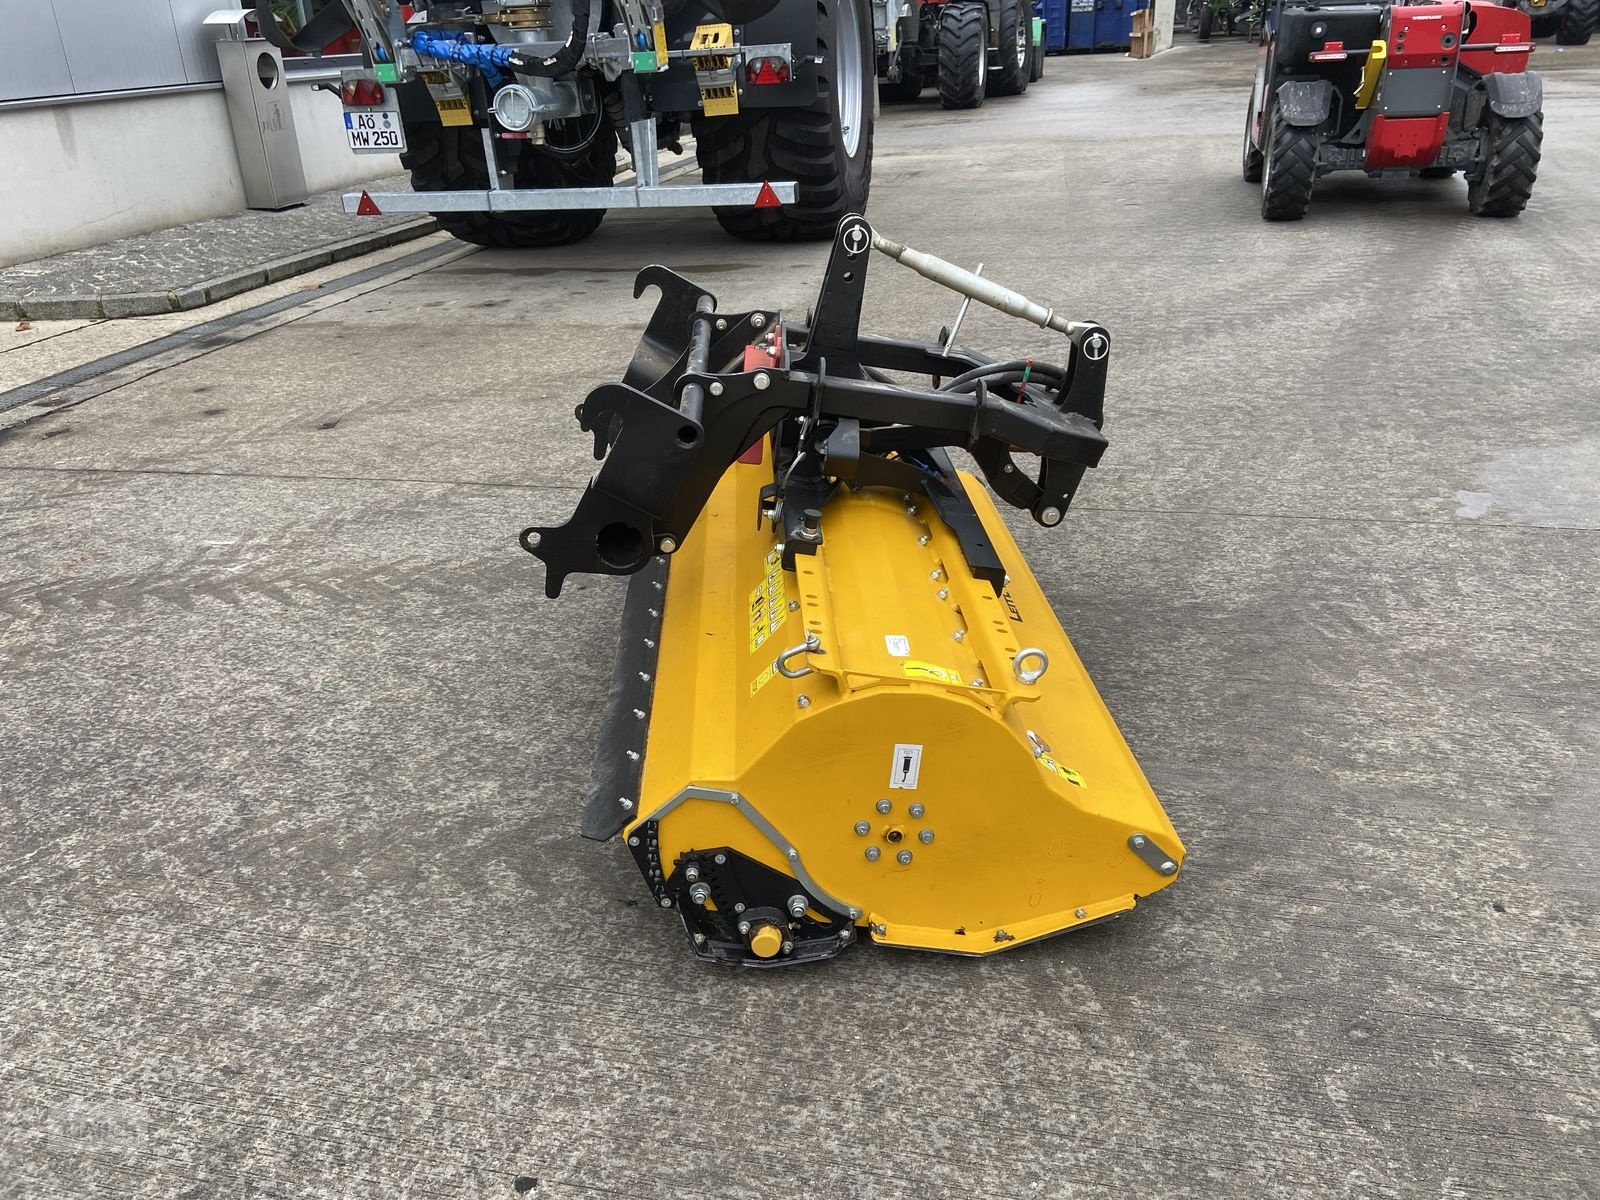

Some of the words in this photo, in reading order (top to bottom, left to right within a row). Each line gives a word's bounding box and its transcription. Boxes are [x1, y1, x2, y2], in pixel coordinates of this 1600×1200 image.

[358, 114, 375, 129] AÖ
[351, 131, 370, 146] MW
[372, 131, 398, 146] 250
